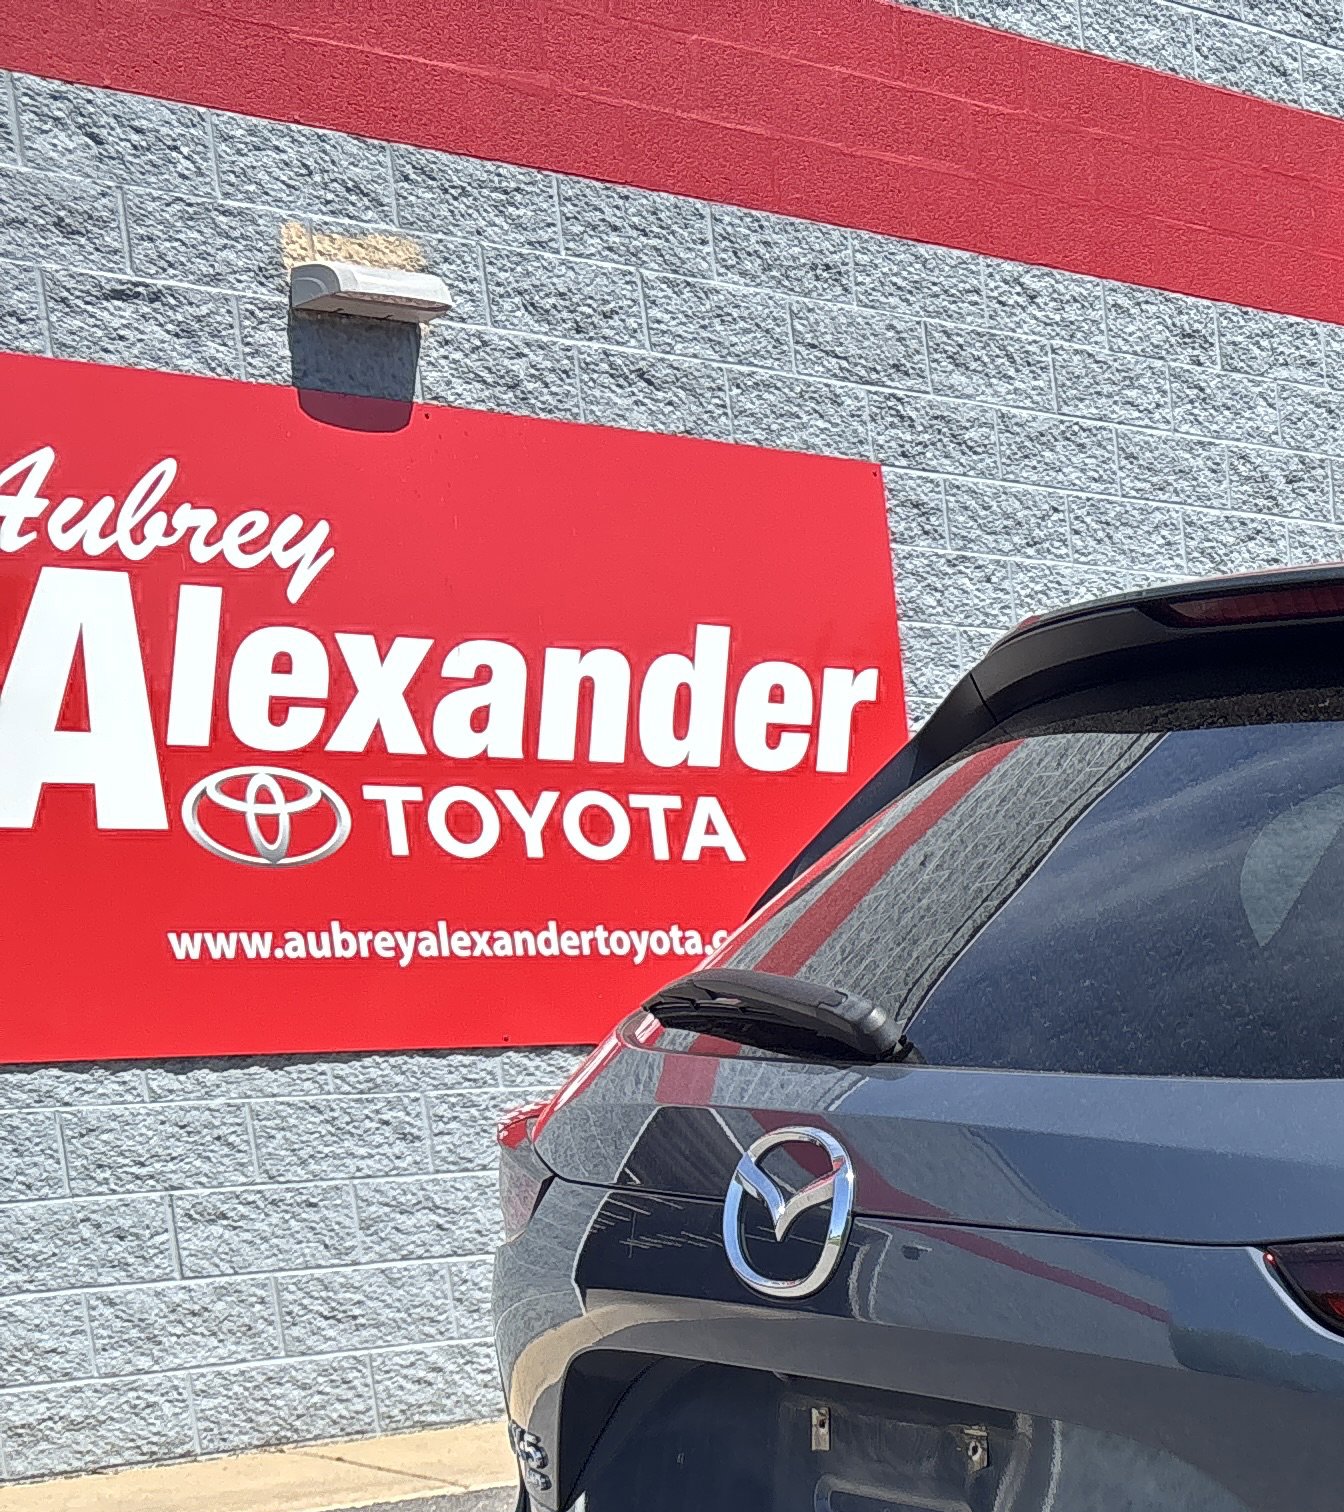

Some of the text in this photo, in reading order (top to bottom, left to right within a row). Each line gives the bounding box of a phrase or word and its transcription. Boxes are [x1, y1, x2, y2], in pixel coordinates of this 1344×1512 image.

[0, 446, 335, 605] Aubrey
[0, 566, 880, 831] Alexander
[362, 784, 747, 862] TOYOTA
